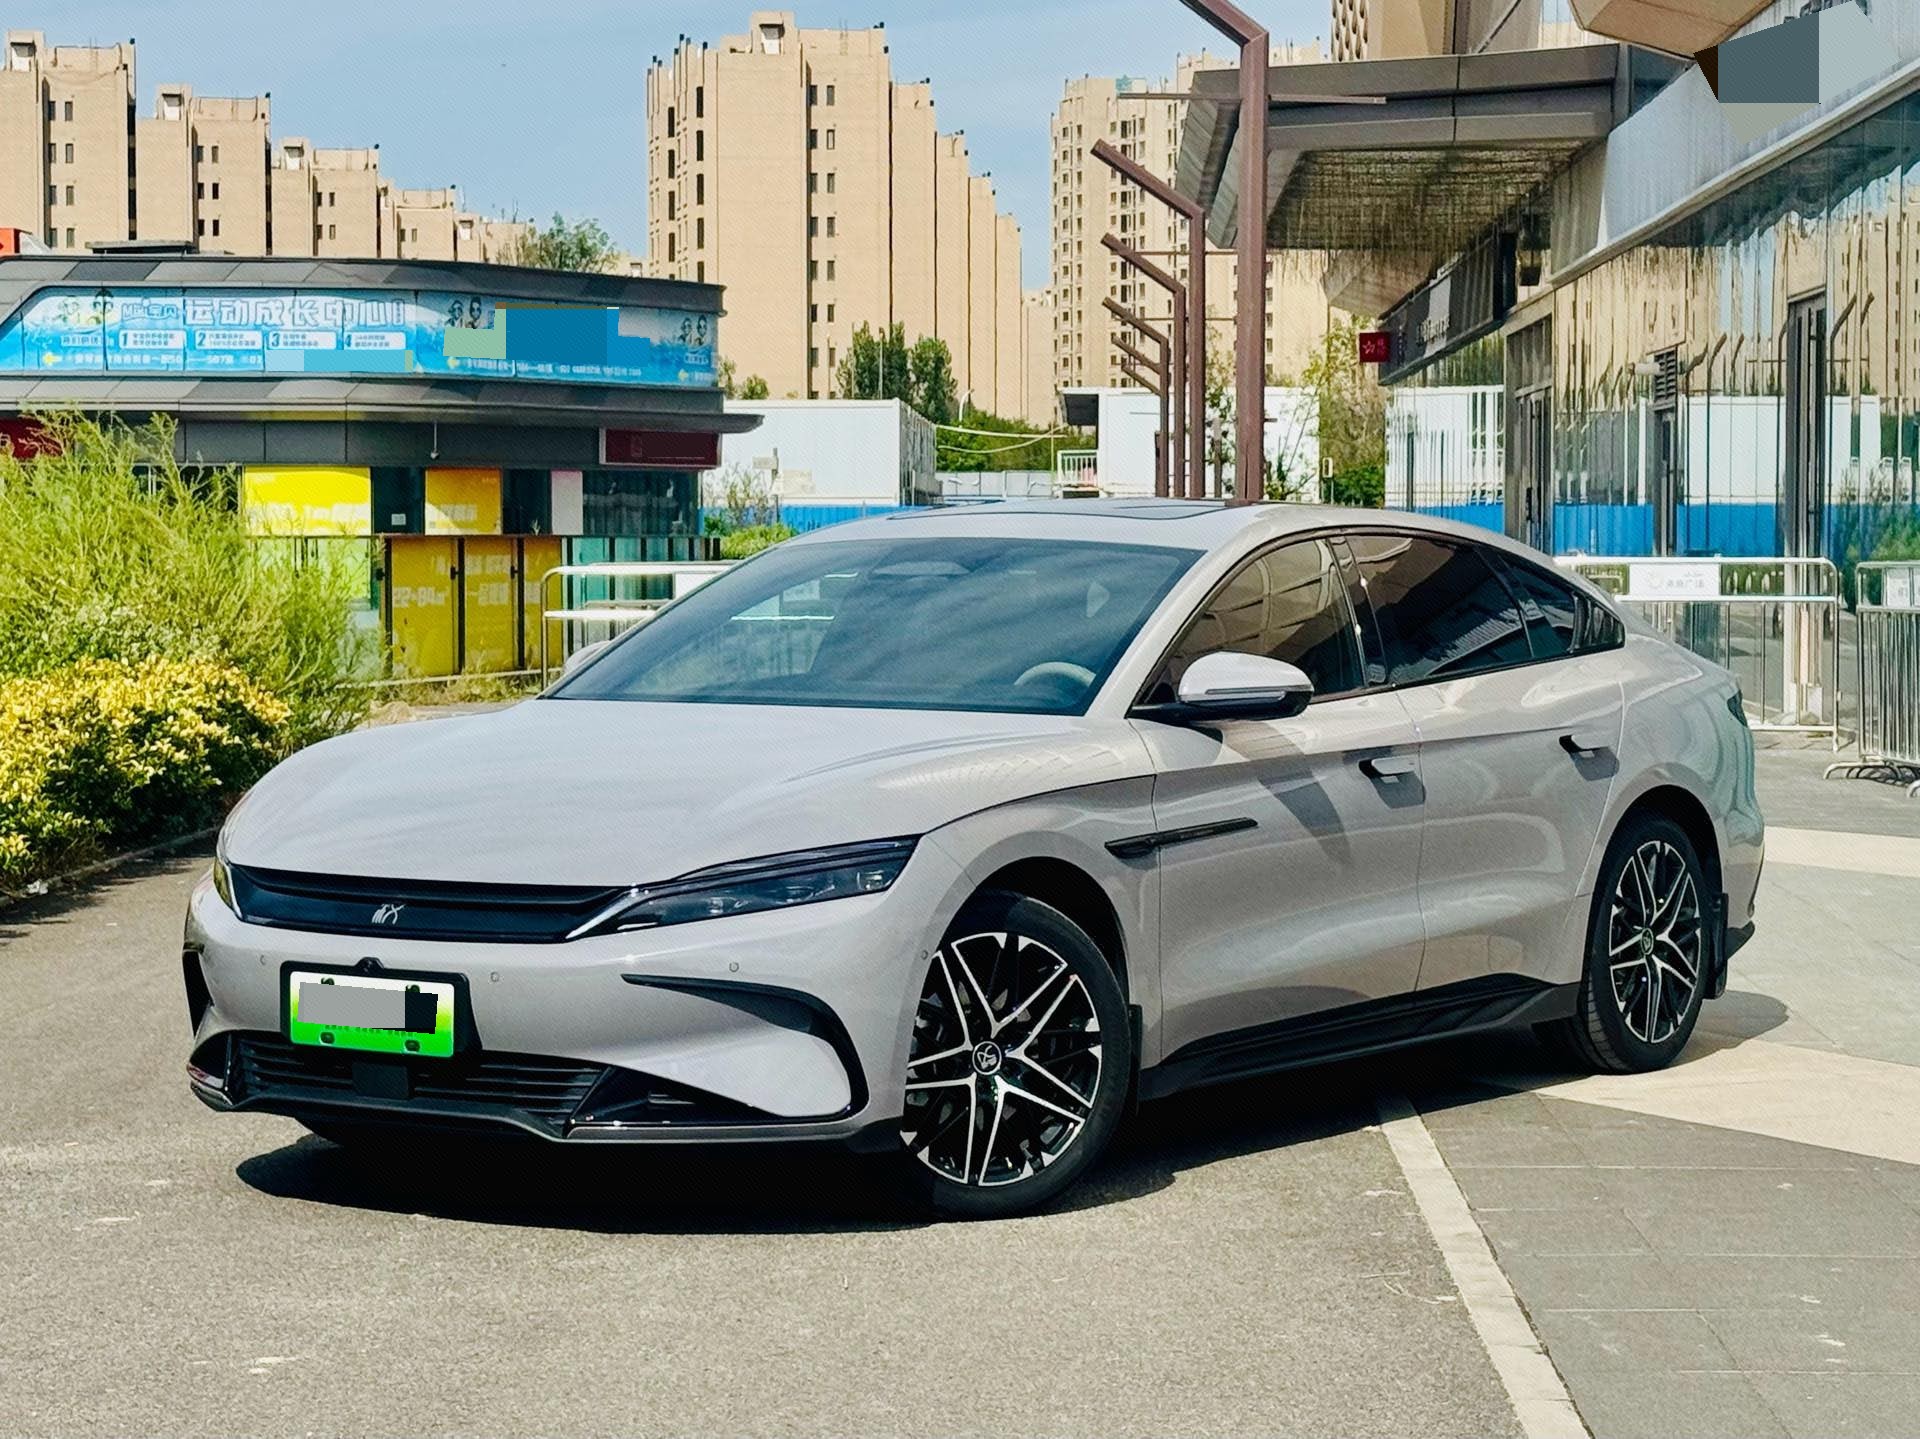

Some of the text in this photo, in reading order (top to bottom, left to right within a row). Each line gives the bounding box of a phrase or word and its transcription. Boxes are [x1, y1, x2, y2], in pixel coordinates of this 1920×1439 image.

[185, 298, 391, 327] 运动成长中心
[122, 333, 128, 346] 1
[198, 332, 206, 346] 2
[271, 333, 280, 347] 3
